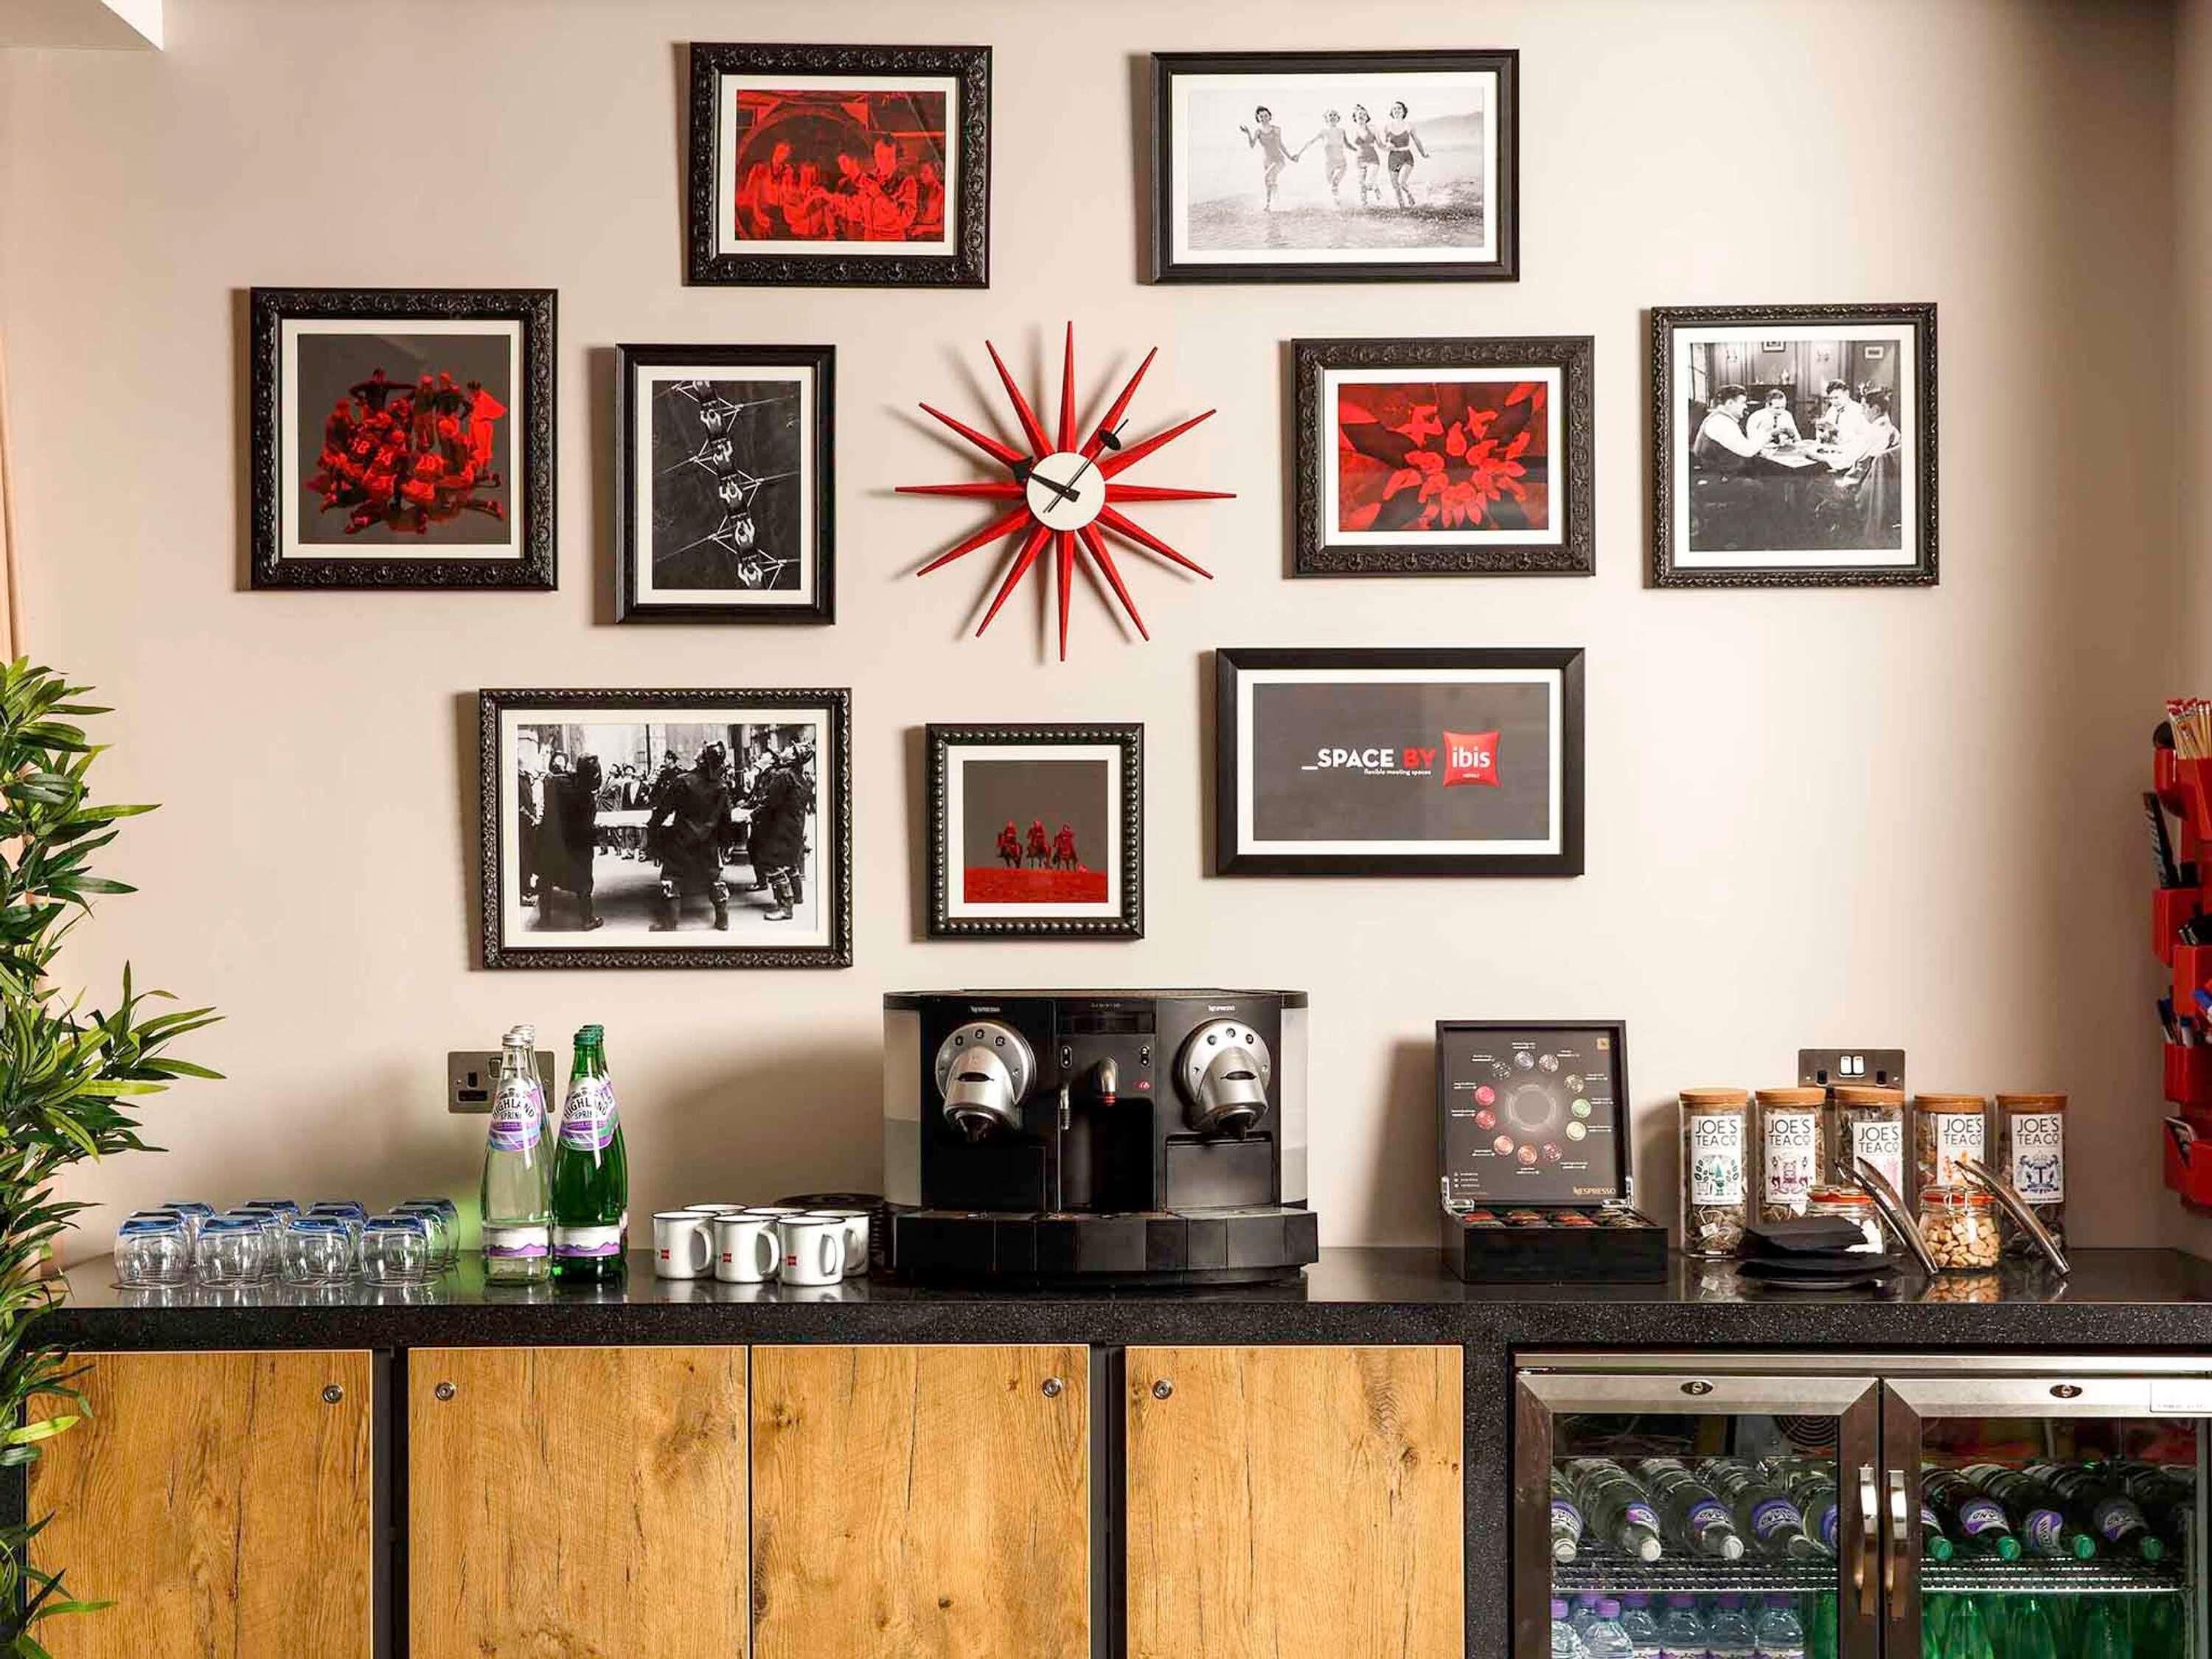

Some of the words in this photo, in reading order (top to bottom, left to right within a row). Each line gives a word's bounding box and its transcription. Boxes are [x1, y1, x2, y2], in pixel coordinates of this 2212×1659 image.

[1403, 748, 1436, 768] BY
[1452, 746, 1492, 768] ibis
[501, 1111, 524, 1120] SPRIN
[563, 1098, 608, 1119] HIGHLND
[1695, 1119, 1738, 1135] JOE'S
[1769, 1118, 1811, 1134] JOE'S
[1944, 1117, 1983, 1133] JOE'S
[2017, 1117, 2059, 1133] JOE'S
[1694, 1135, 1719, 1147] TEA
[1769, 1135, 1792, 1146] TEA
[1859, 1125, 1899, 1142] JOE'S
[1944, 1133, 1966, 1145] TEA
[2017, 1133, 2042, 1145] TEA
[1859, 1142, 1881, 1154] TEA
